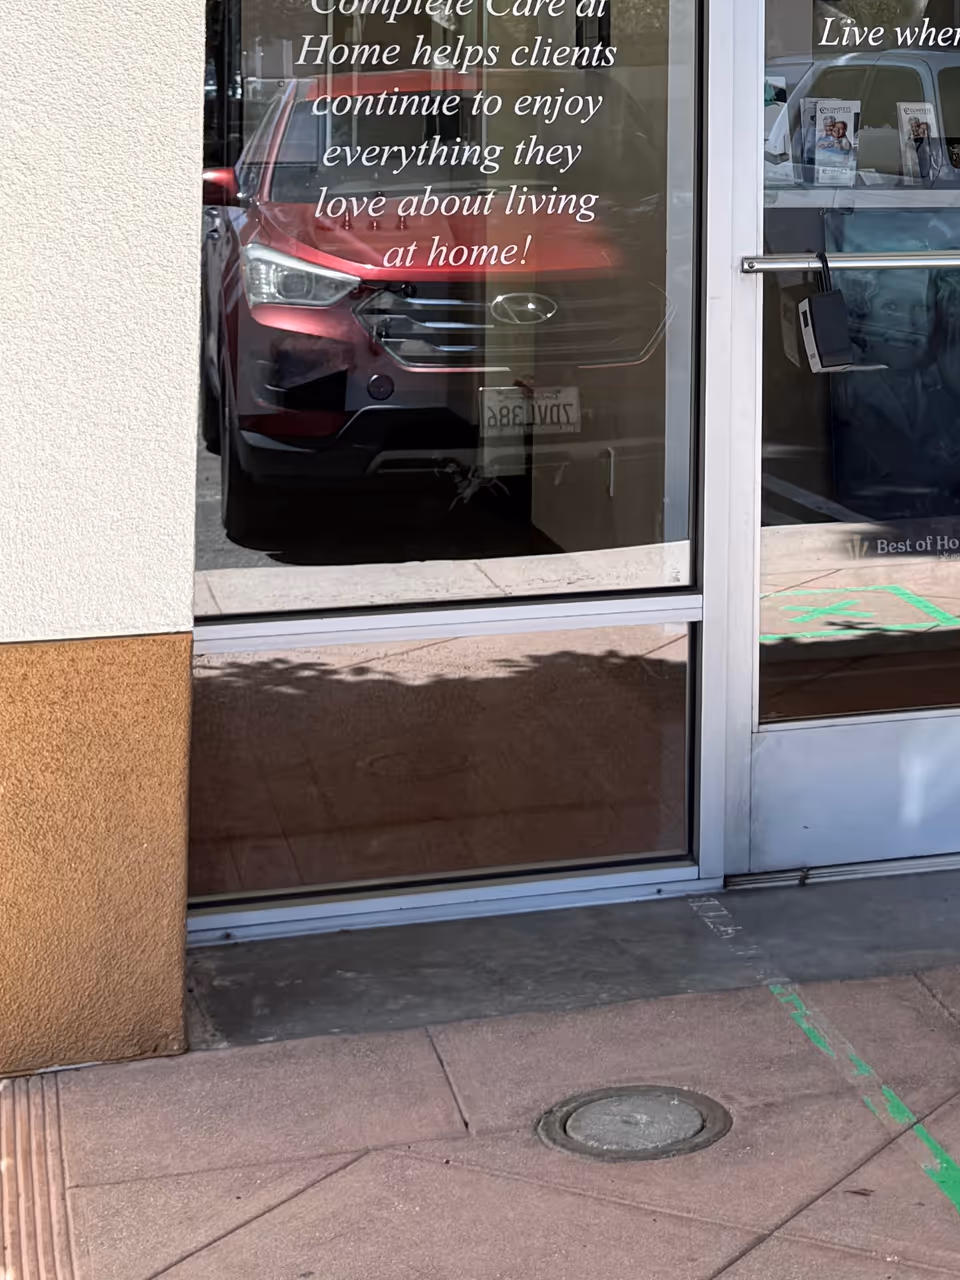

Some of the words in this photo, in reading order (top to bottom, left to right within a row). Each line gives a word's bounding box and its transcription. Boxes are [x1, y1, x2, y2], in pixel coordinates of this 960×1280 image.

[818, 17, 884, 47] Live
[295, 35, 400, 67] Home
[411, 35, 500, 73] helps
[511, 37, 617, 68] clients
[311, 87, 460, 116] continue
[472, 93, 503, 117] to
[513, 88, 603, 124] enjoy
[322, 136, 504, 174] everything
[514, 136, 582, 173] they
[314, 186, 387, 218] love
[397, 186, 496, 217] about
[504, 185, 600, 222] living
[382, 241, 417, 268] at
[426, 235, 533, 267] home!
[877, 538, 912, 554] Best
[916, 536, 932, 551] of
